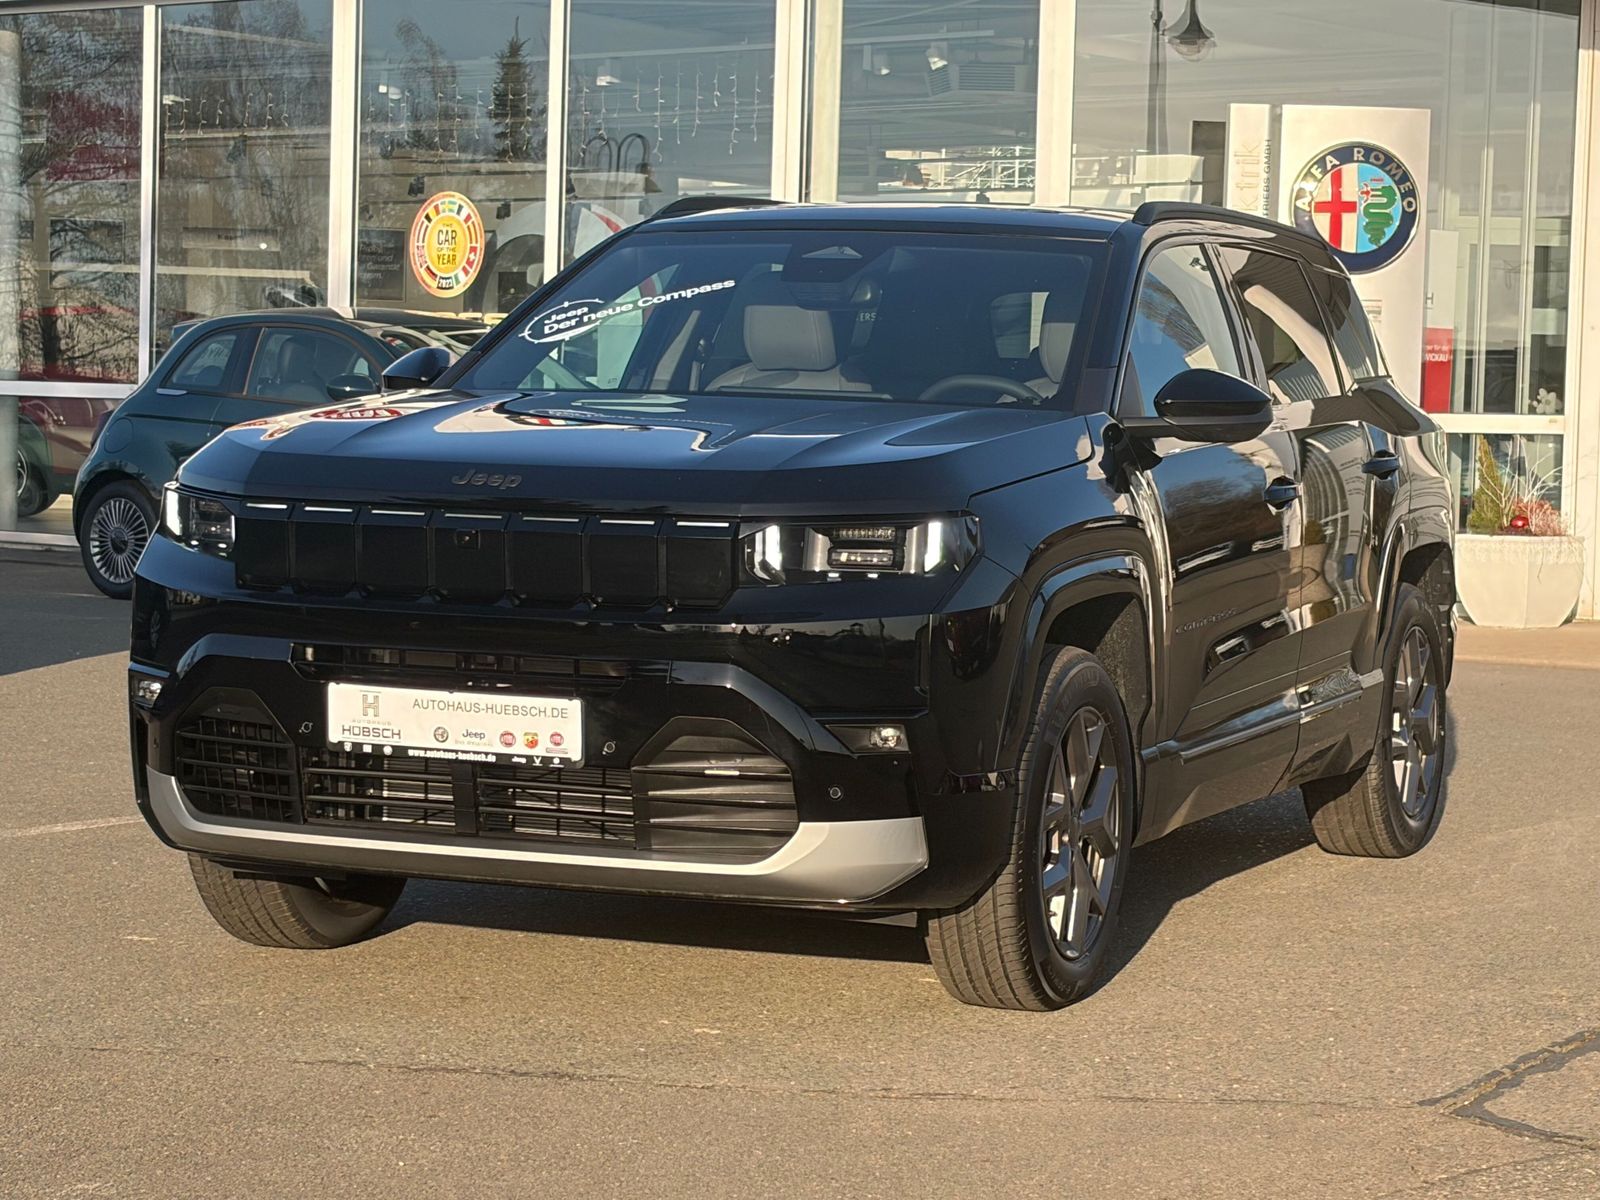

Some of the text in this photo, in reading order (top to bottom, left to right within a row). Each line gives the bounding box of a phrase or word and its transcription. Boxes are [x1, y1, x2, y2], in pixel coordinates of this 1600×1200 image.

[1353, 147, 1417, 213] ROMEO
[437, 230, 457, 246] CAR
[436, 254, 457, 265] YEAR
[544, 280, 736, 334] Der neue Compass
[544, 307, 589, 324] Jeep
[451, 469, 522, 490] Jeep
[412, 699, 569, 719] AUTOHAUS-HUEBSCH.DE
[462, 729, 486, 740] Jeep
